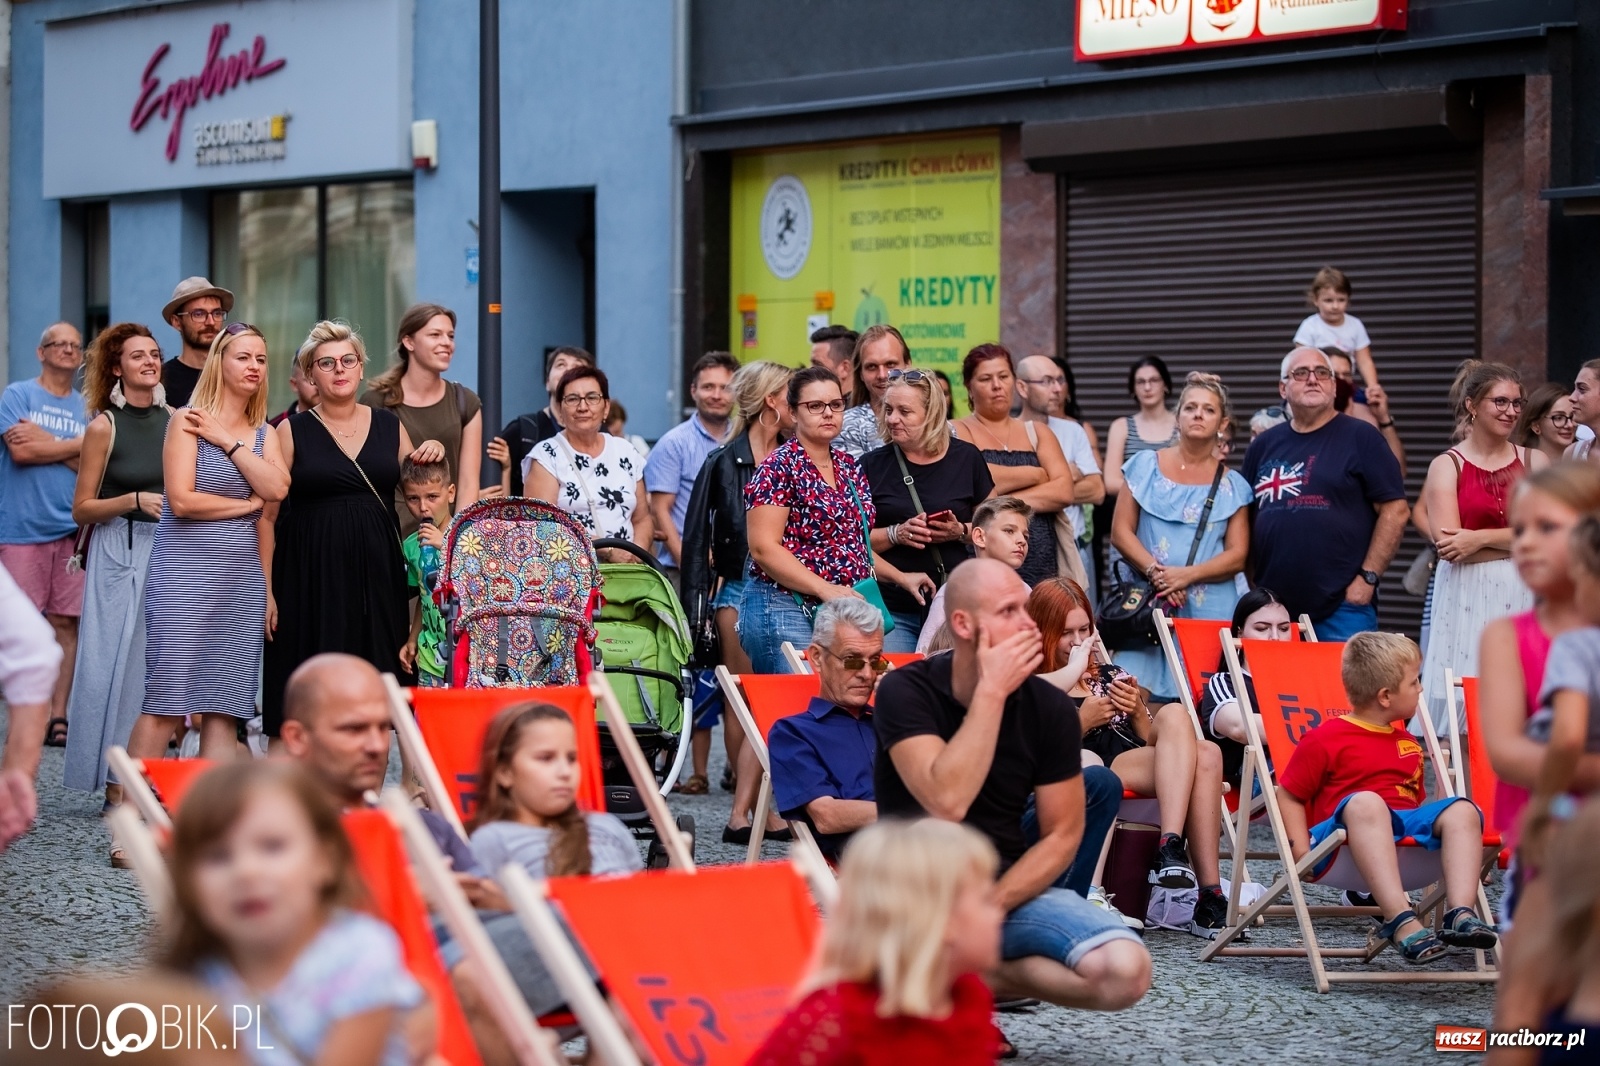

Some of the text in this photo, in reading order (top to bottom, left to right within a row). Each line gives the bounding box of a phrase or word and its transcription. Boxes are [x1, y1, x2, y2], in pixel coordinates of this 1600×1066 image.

[838, 158, 899, 181] KREDYTY
[909, 150, 995, 176] CHWILÓWKI
[899, 275, 996, 307] KREDYTY
